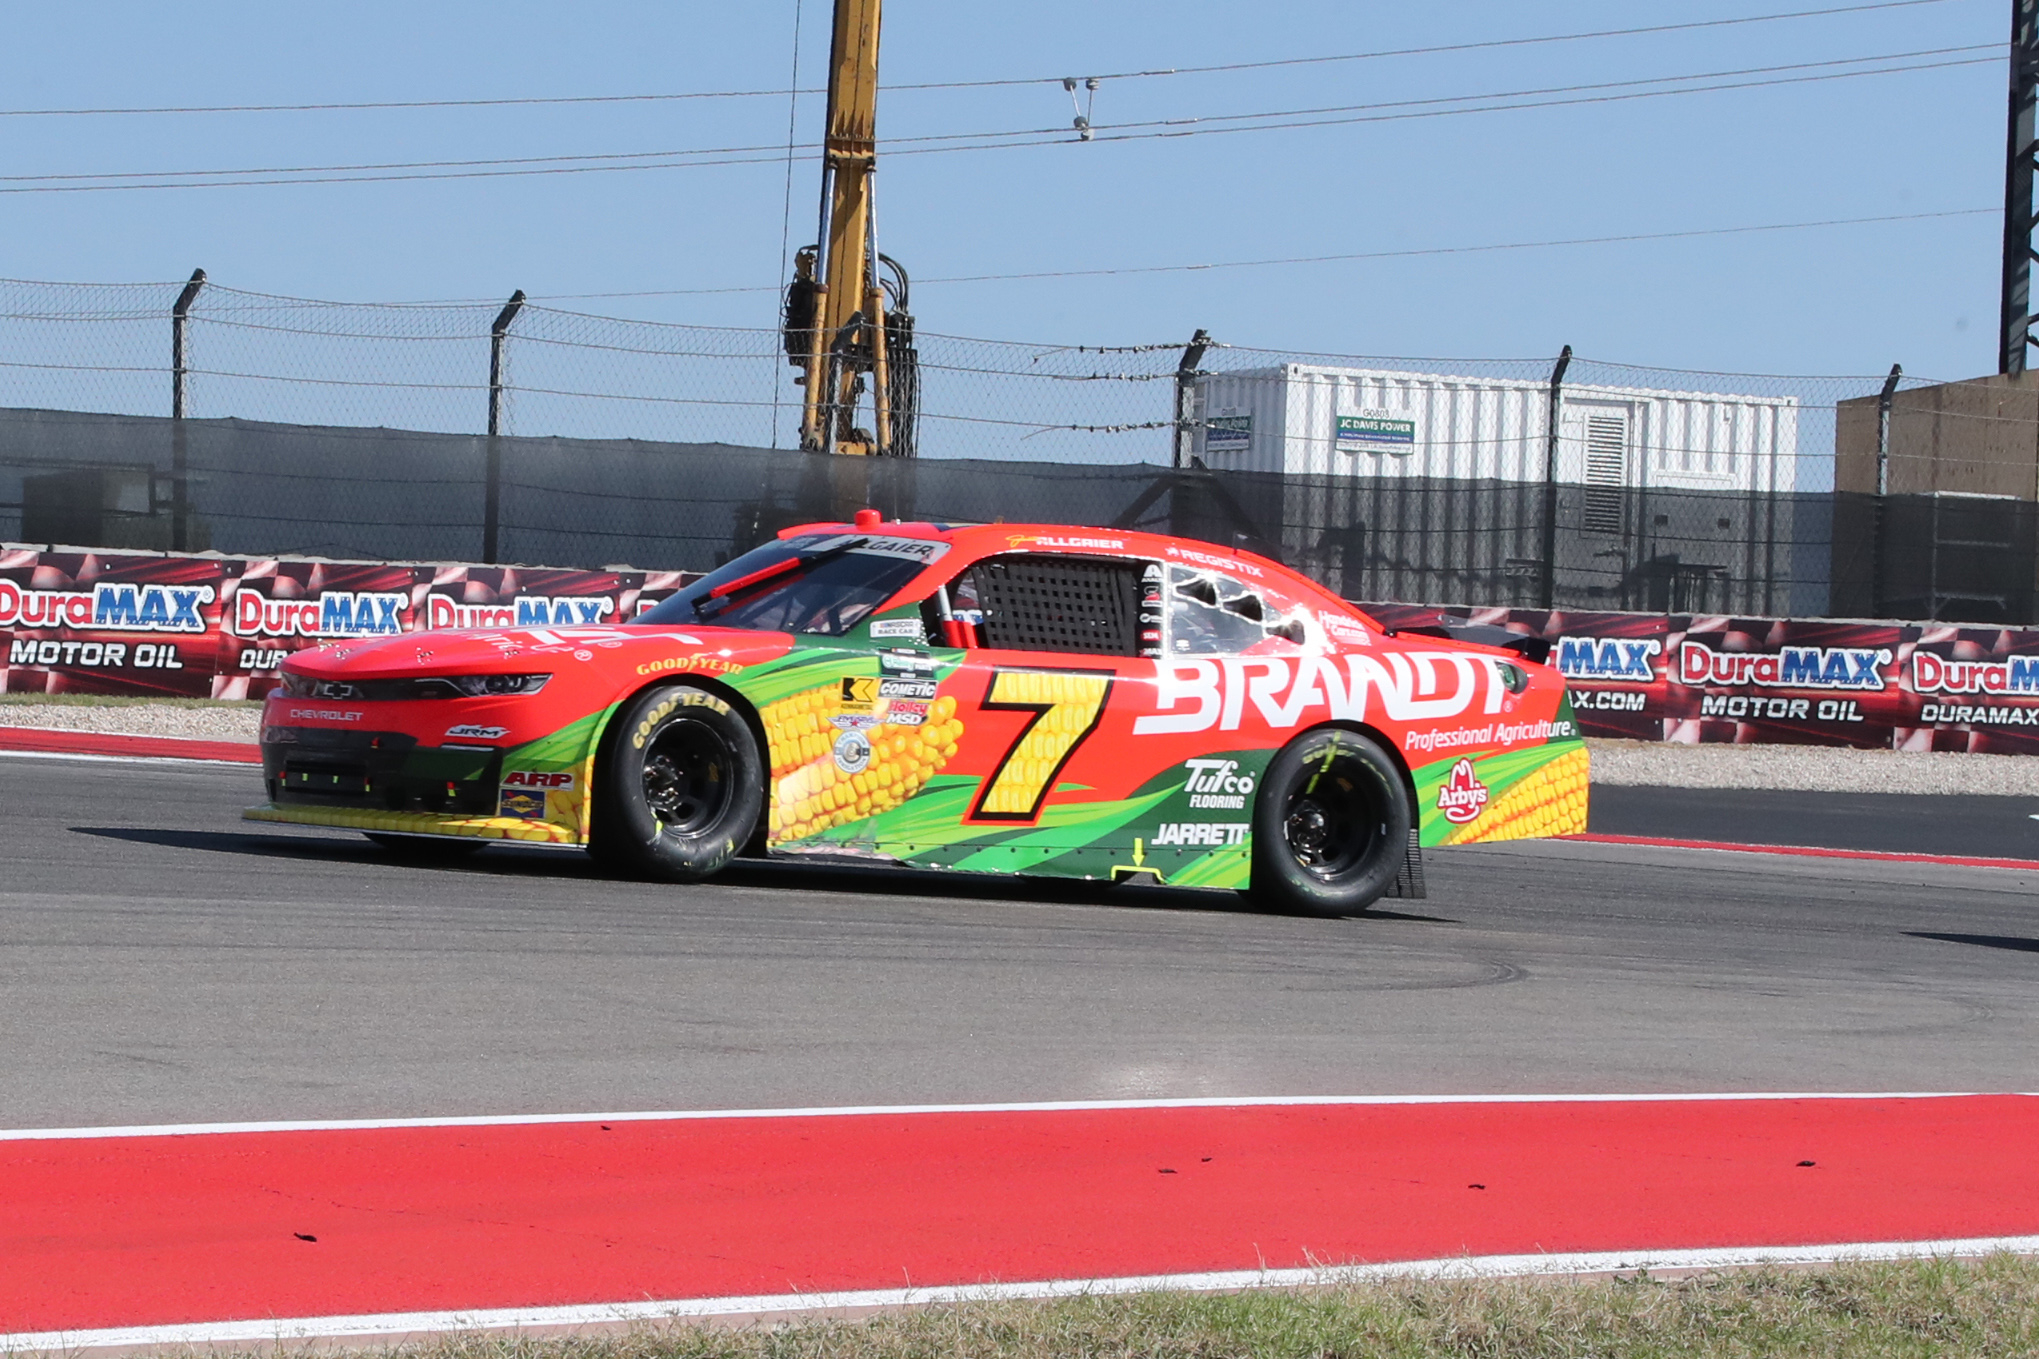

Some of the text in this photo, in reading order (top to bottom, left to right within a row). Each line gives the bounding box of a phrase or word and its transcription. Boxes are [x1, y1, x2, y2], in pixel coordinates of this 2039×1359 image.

[1340, 419, 1411, 432] JC DAVIS POWER
[1179, 549, 1264, 578] REGISTIX
[9, 640, 183, 669] MOTOR OIL
[637, 656, 744, 675] GOODYEAR
[1132, 653, 1513, 735] BRANDT
[290, 709, 363, 721] CHEVROLET
[886, 713, 922, 725] MSD
[1701, 695, 1864, 722] MOTOR OIL
[449, 728, 500, 738] JRM
[969, 663, 1117, 821] 7
[1405, 720, 1572, 751] Professional Agriculture
[504, 772, 573, 787] ARP
[1184, 759, 1254, 794] Tufco
[1189, 795, 1245, 809] FLOORING
[1438, 784, 1488, 808] Arby's
[1151, 823, 1249, 845] JARRETT
